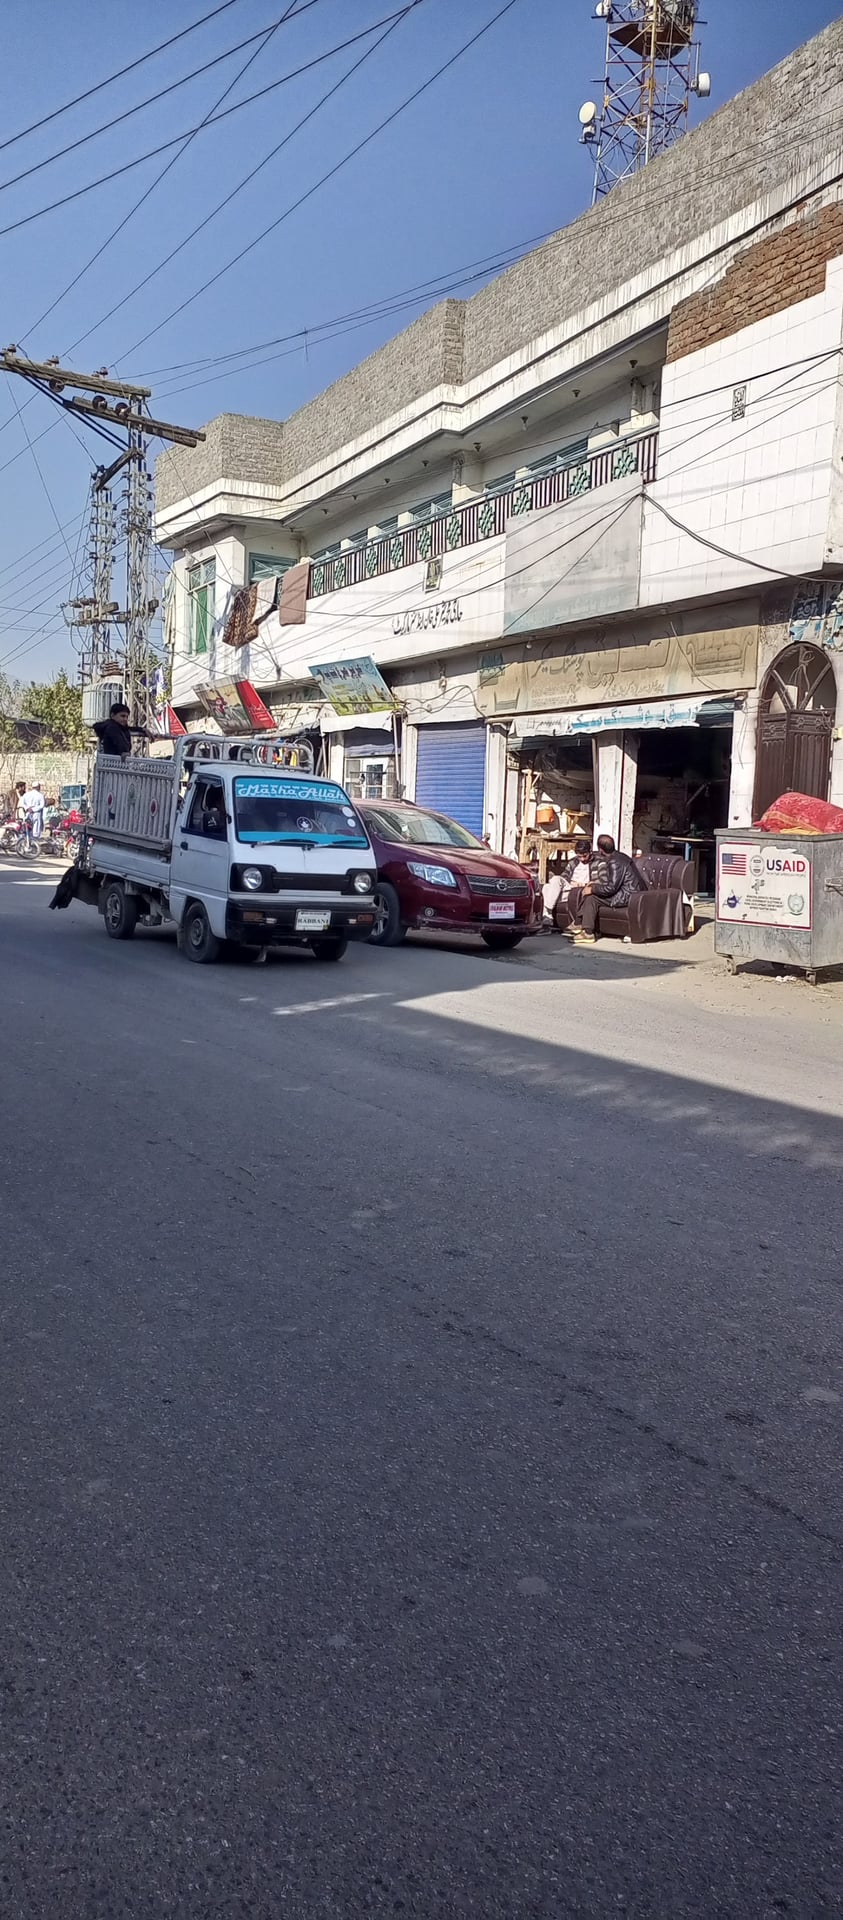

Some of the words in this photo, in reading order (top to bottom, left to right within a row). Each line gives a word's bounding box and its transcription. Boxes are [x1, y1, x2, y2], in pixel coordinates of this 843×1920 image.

[238, 784, 297, 797] Masha
[298, 787, 344, 800] Allah
[766, 859, 806, 872] USAID
